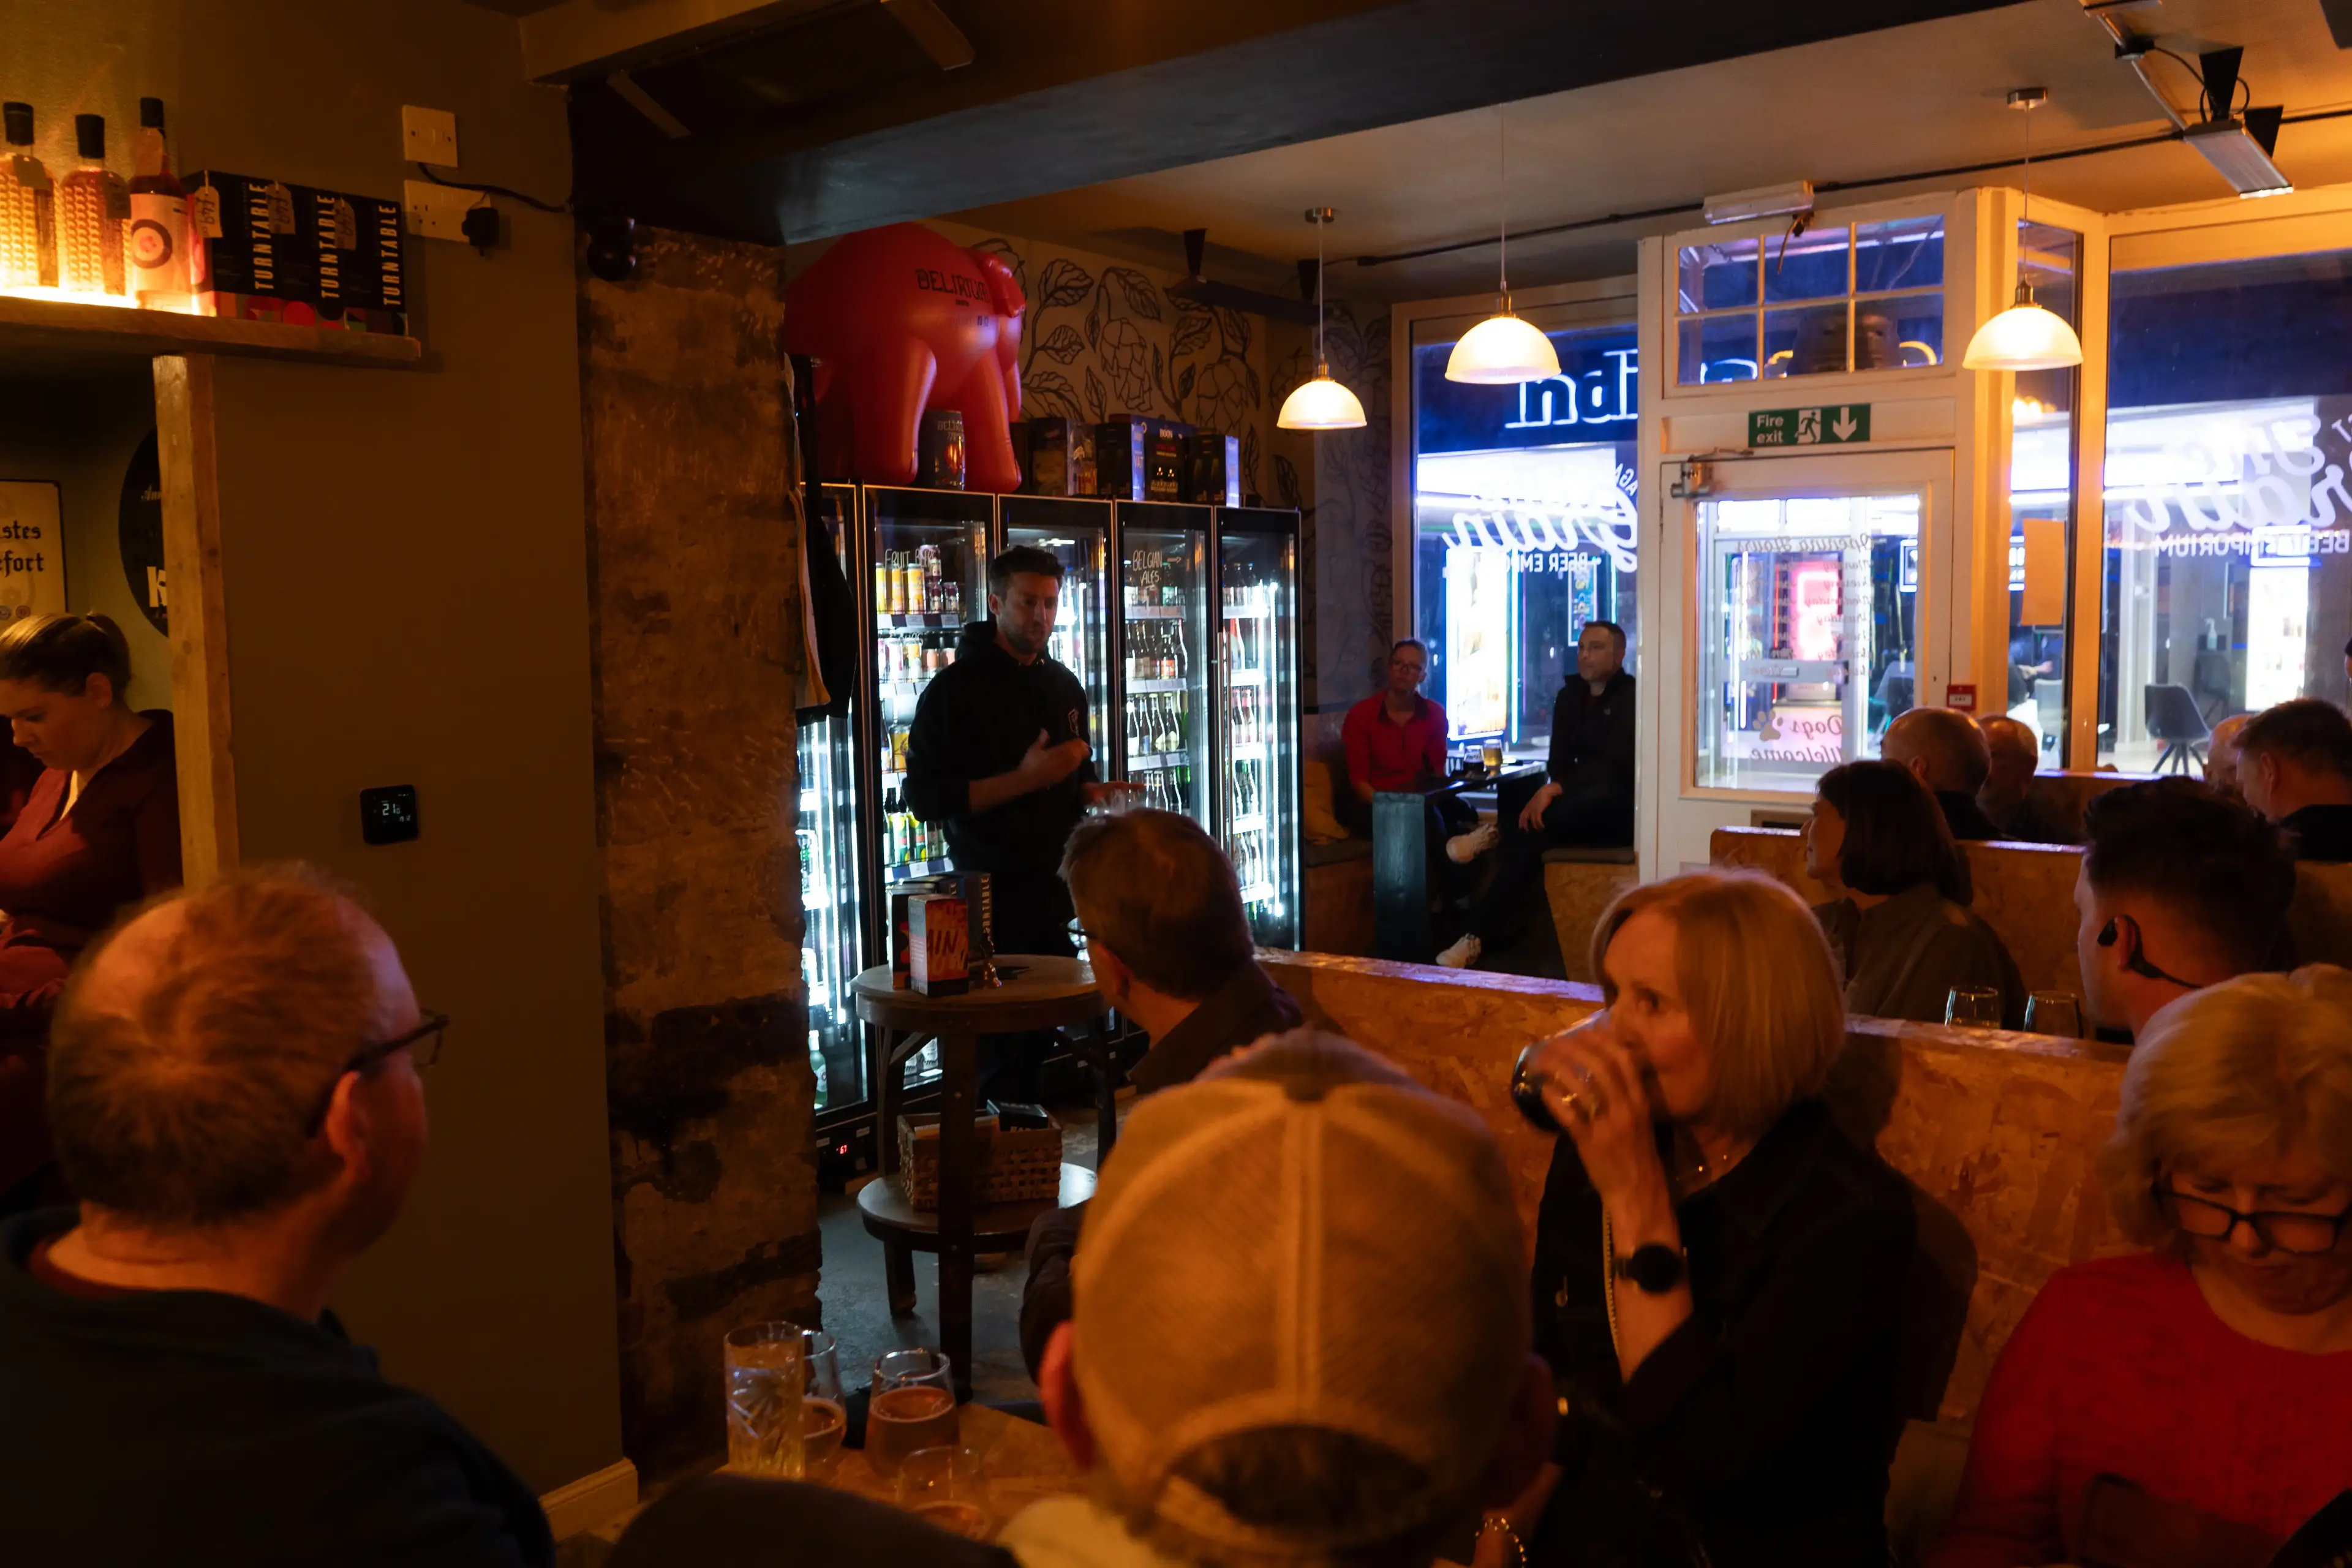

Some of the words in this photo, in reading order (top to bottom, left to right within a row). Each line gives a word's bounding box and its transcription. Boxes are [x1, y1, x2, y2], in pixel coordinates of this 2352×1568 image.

[248, 183, 274, 290] TURNTABLE
[317, 194, 341, 299] TURNTABLE
[378, 202, 402, 306] TURNTABLE
[1756, 414, 1784, 428] Fire
[1756, 430, 1784, 443] exit
[0, 521, 42, 540] stes
[884, 548, 911, 571] FRUIT
[1133, 549, 1163, 571] BELGIAN
